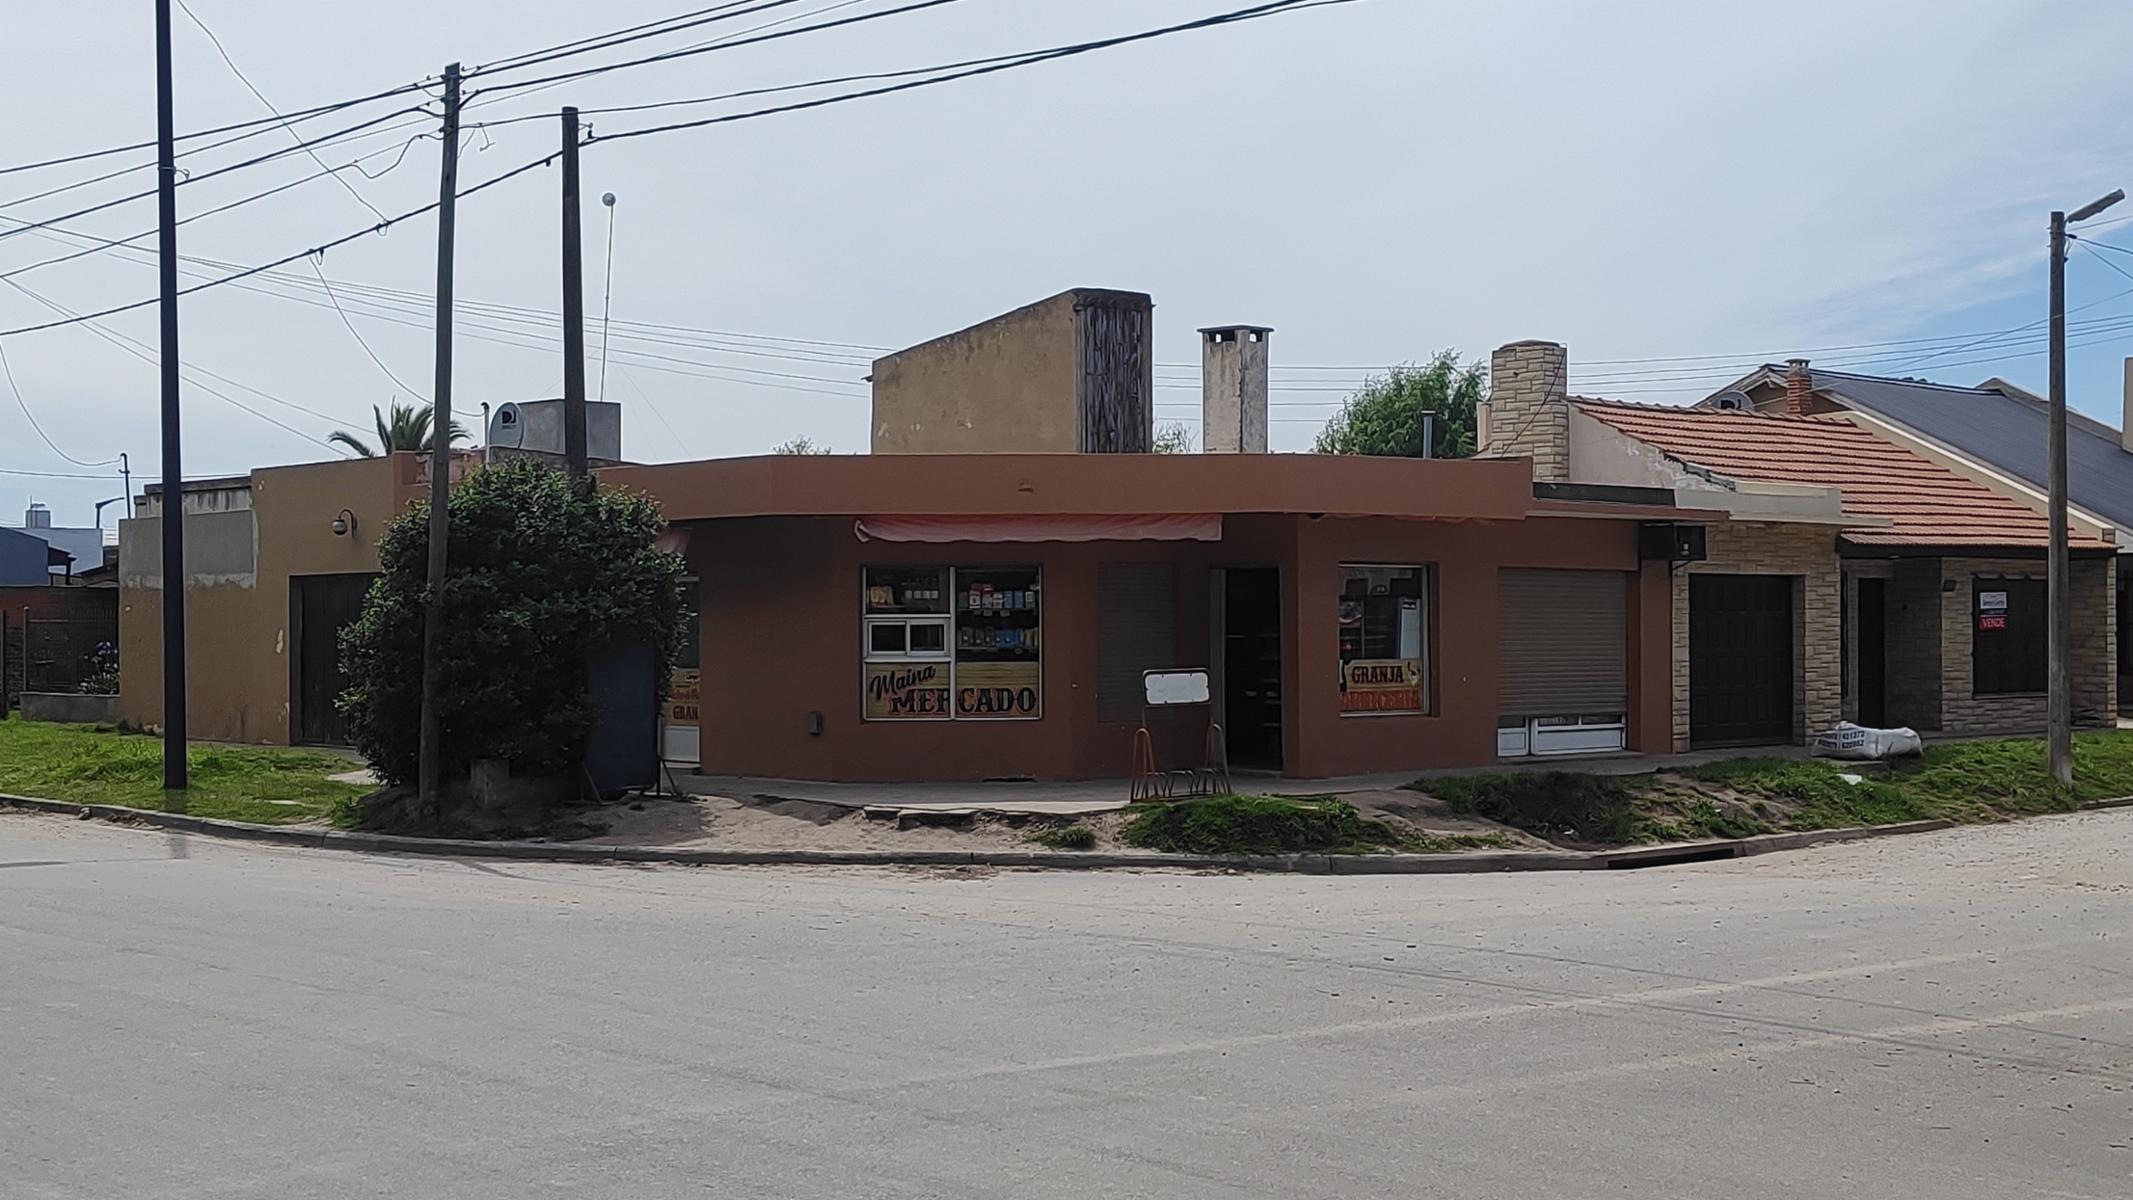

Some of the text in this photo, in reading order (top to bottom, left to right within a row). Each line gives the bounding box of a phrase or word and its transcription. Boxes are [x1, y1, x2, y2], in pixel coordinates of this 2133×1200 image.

[1981, 617, 2006, 628] VENDE
[869, 665, 936, 700] Maina
[1352, 666, 1405, 684] GRANJA
